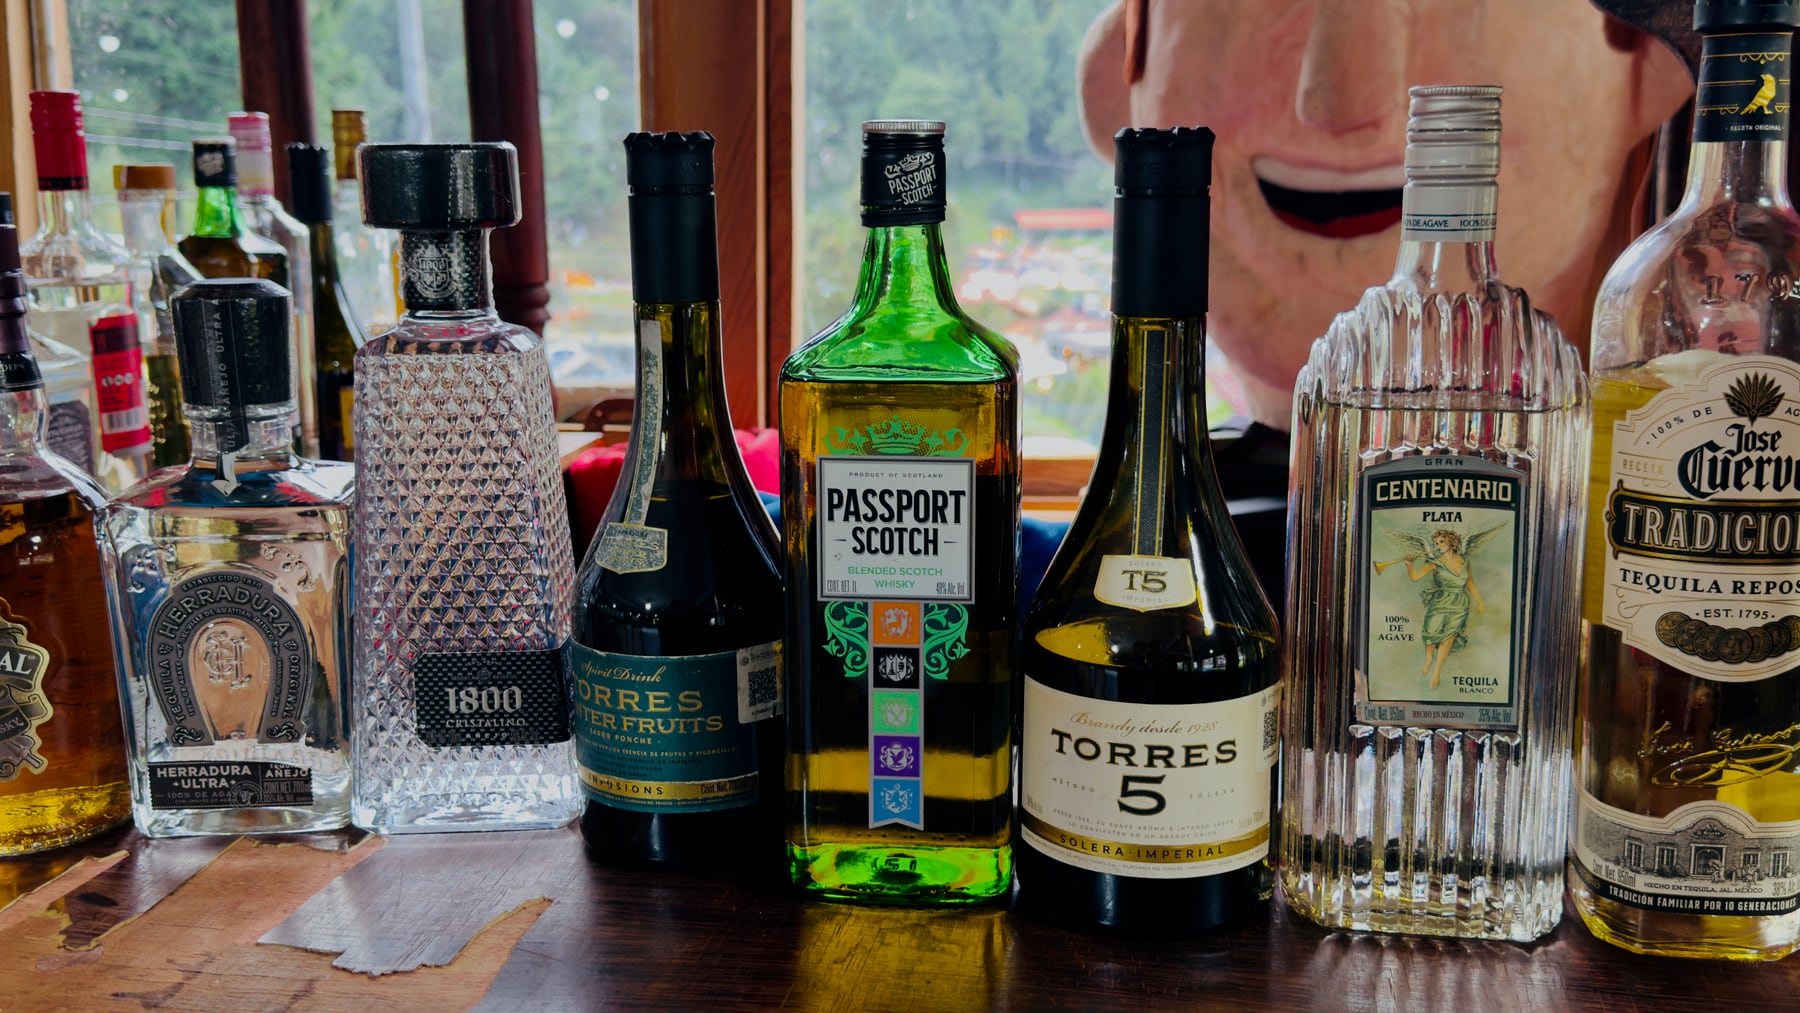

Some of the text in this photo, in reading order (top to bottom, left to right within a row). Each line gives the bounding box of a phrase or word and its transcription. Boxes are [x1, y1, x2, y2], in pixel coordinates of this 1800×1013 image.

[888, 164, 937, 195] PASSPORT
[902, 184, 933, 206] SCOTCH
[1422, 219, 1449, 228] AGAVE
[1651, 416, 1684, 440] 100%
[1692, 406, 1713, 418] DE
[1722, 423, 1782, 458] Jose
[1424, 457, 1464, 466] GRAN
[1623, 458, 1664, 475] RECETA
[1375, 478, 1513, 502] CENTENARIO
[827, 488, 967, 524] PASSPORT
[1422, 511, 1463, 522] PLATA
[851, 526, 939, 556] SCOTCH
[847, 566, 943, 577] BLENDED SCOTCH
[1121, 569, 1168, 593] T5
[1620, 567, 1723, 594] TEQUILA
[874, 580, 916, 589] WHISKY
[159, 586, 291, 639] HERRADURA
[1384, 615, 1411, 624] 100%
[1703, 608, 1769, 620] EST. 1795
[1377, 633, 1415, 642] AGAVE
[1389, 624, 1404, 633] DE
[581, 661, 667, 683] Spirit Drink
[1452, 676, 1499, 687] TEQUILA
[159, 659, 186, 722] TEQUILA
[283, 655, 300, 719] ORIGINAL
[1458, 687, 1495, 695] BLANCO
[444, 685, 523, 714] 1800
[445, 718, 526, 728] CRISTALINO
[622, 715, 724, 734] FRUITS
[1070, 711, 1136, 738] Brandy
[1138, 720, 1183, 734] desde
[1412, 710, 1432, 719] HECHO
[1432, 711, 1441, 719] EN
[615, 734, 653, 744] PONCHE
[1051, 728, 1238, 769] TORRES
[157, 764, 309, 778] HERRADURA AÑEJO
[180, 778, 230, 789] ULTRA
[1116, 774, 1167, 816] 5
[1059, 834, 1124, 857] SOLERA
[1137, 845, 1225, 859] IMPERIAL
[1644, 881, 1671, 890] HECHO
[1672, 883, 1683, 891] EN
[1683, 884, 1718, 893] TEQUILA,
[1609, 884, 1797, 911] TRADICIÓN FAMILIAR POR 10 GENERACIONES
